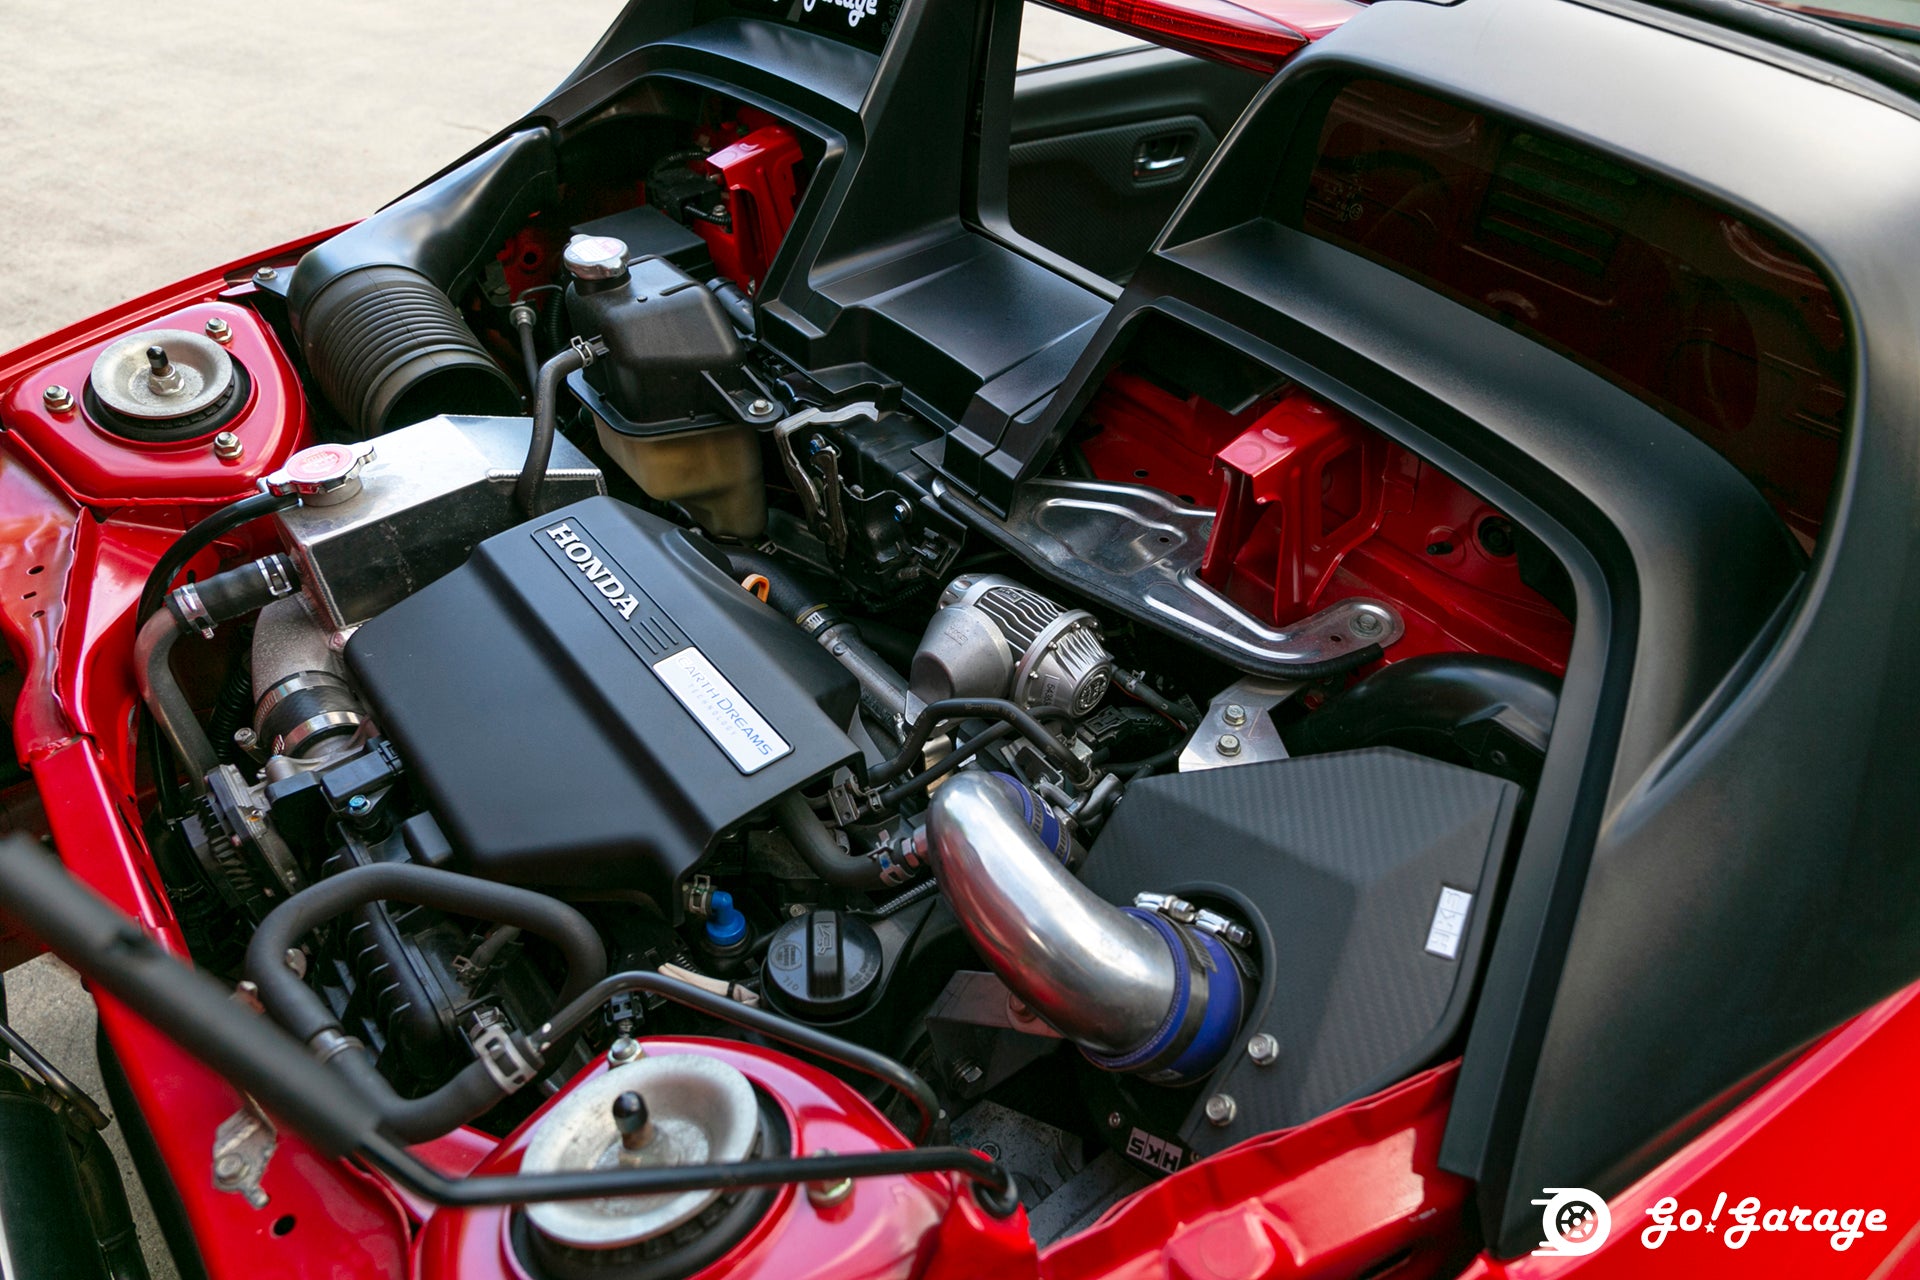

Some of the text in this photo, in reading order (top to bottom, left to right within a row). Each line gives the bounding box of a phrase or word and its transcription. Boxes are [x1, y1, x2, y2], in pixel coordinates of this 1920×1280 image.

[546, 522, 640, 622] HONDA
[678, 655, 773, 756] EARTH DREAMS
[1128, 1136, 1179, 1173] HKS
